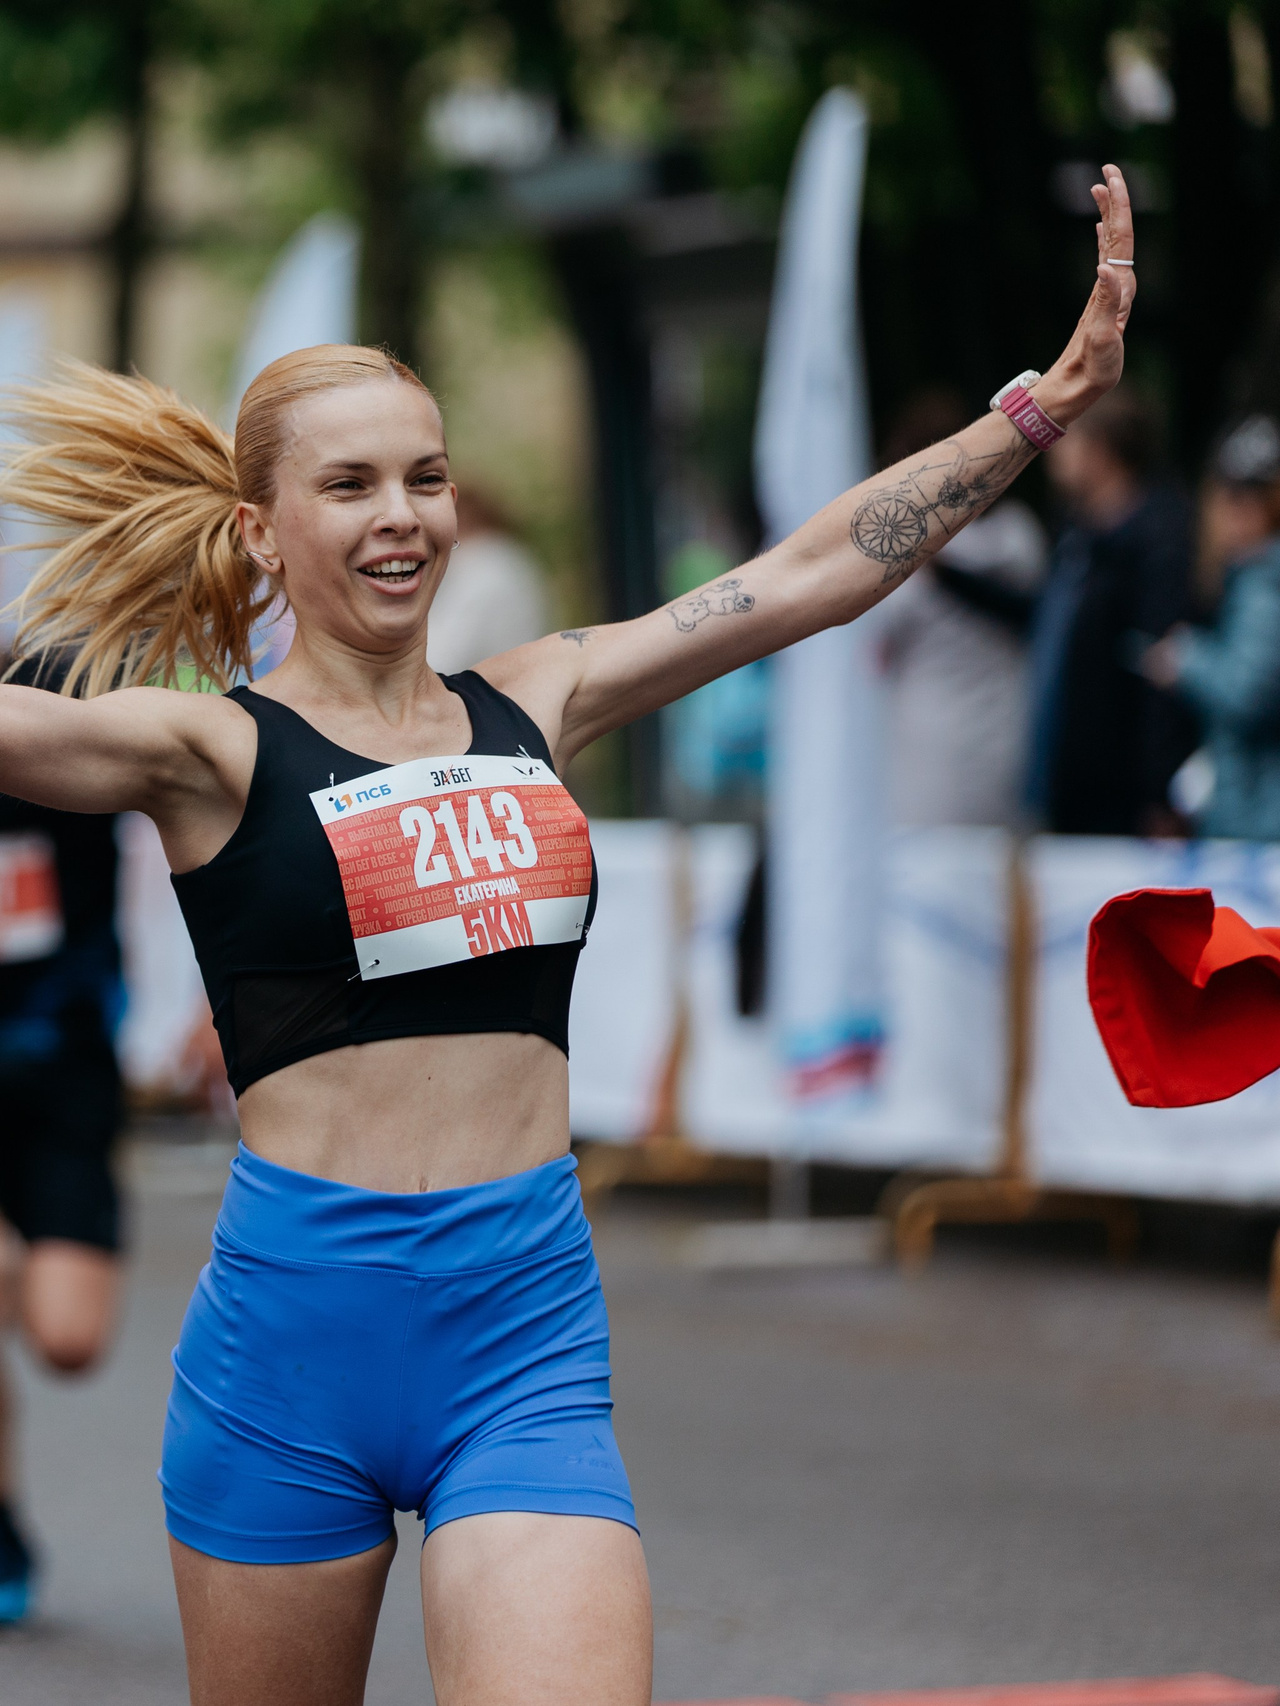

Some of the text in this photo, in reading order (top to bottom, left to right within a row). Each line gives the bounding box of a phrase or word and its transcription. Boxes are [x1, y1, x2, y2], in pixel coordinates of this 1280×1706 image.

[356, 784, 391, 803] ПСБ
[329, 809, 380, 833] КИЛОМЕТРЫ
[399, 791, 538, 888] 2143
[377, 852, 398, 867] СЕБЕ
[355, 872, 383, 891] ДАВНО
[382, 864, 414, 881] ОТСТАЛ
[373, 882, 407, 900] ТОЛЬКО
[454, 876, 521, 905] ЕКАТЕРИНА
[384, 897, 410, 914] ЛЮБИ
[409, 893, 424, 909] БЕГ
[431, 887, 452, 903] СЕБЕ
[351, 920, 382, 937] РУЗКА
[395, 908, 427, 927] СТРЕСС
